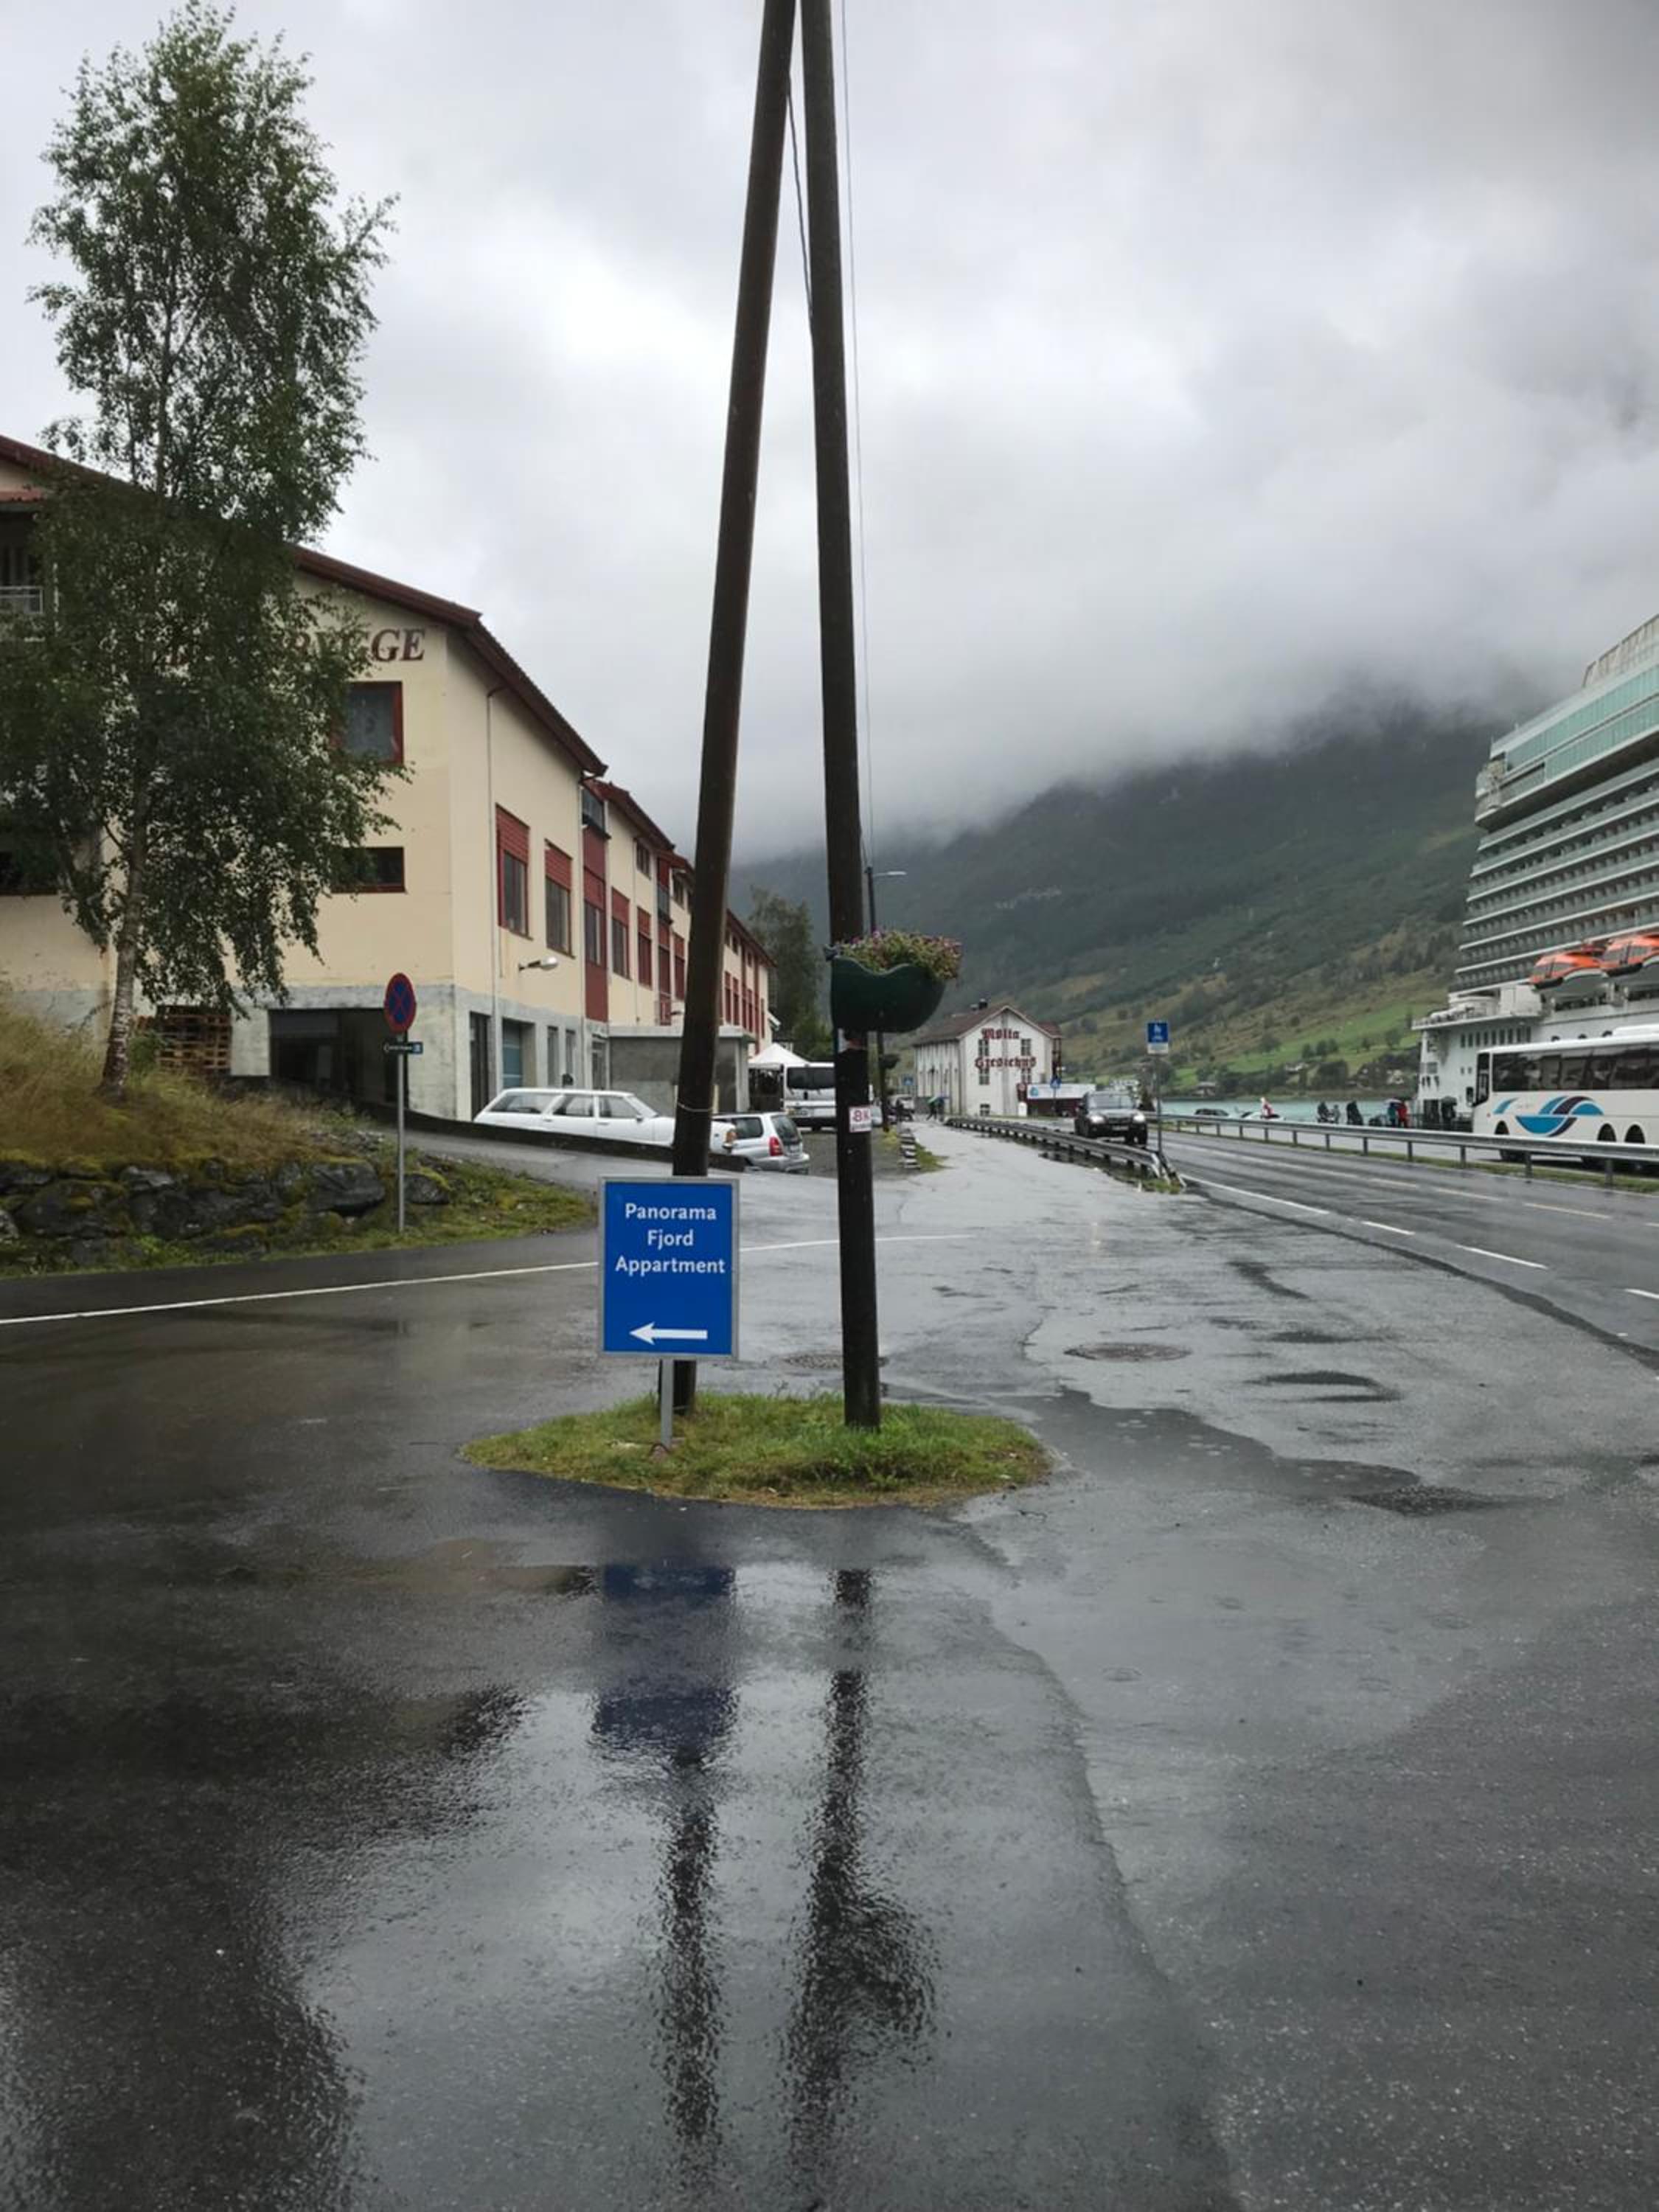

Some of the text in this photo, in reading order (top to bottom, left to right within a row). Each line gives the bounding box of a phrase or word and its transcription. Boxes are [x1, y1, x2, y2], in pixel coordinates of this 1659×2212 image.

[625, 1203, 717, 1220] Panorama
[647, 1229, 694, 1250] Fjord
[615, 1256, 726, 1277] Appartment
